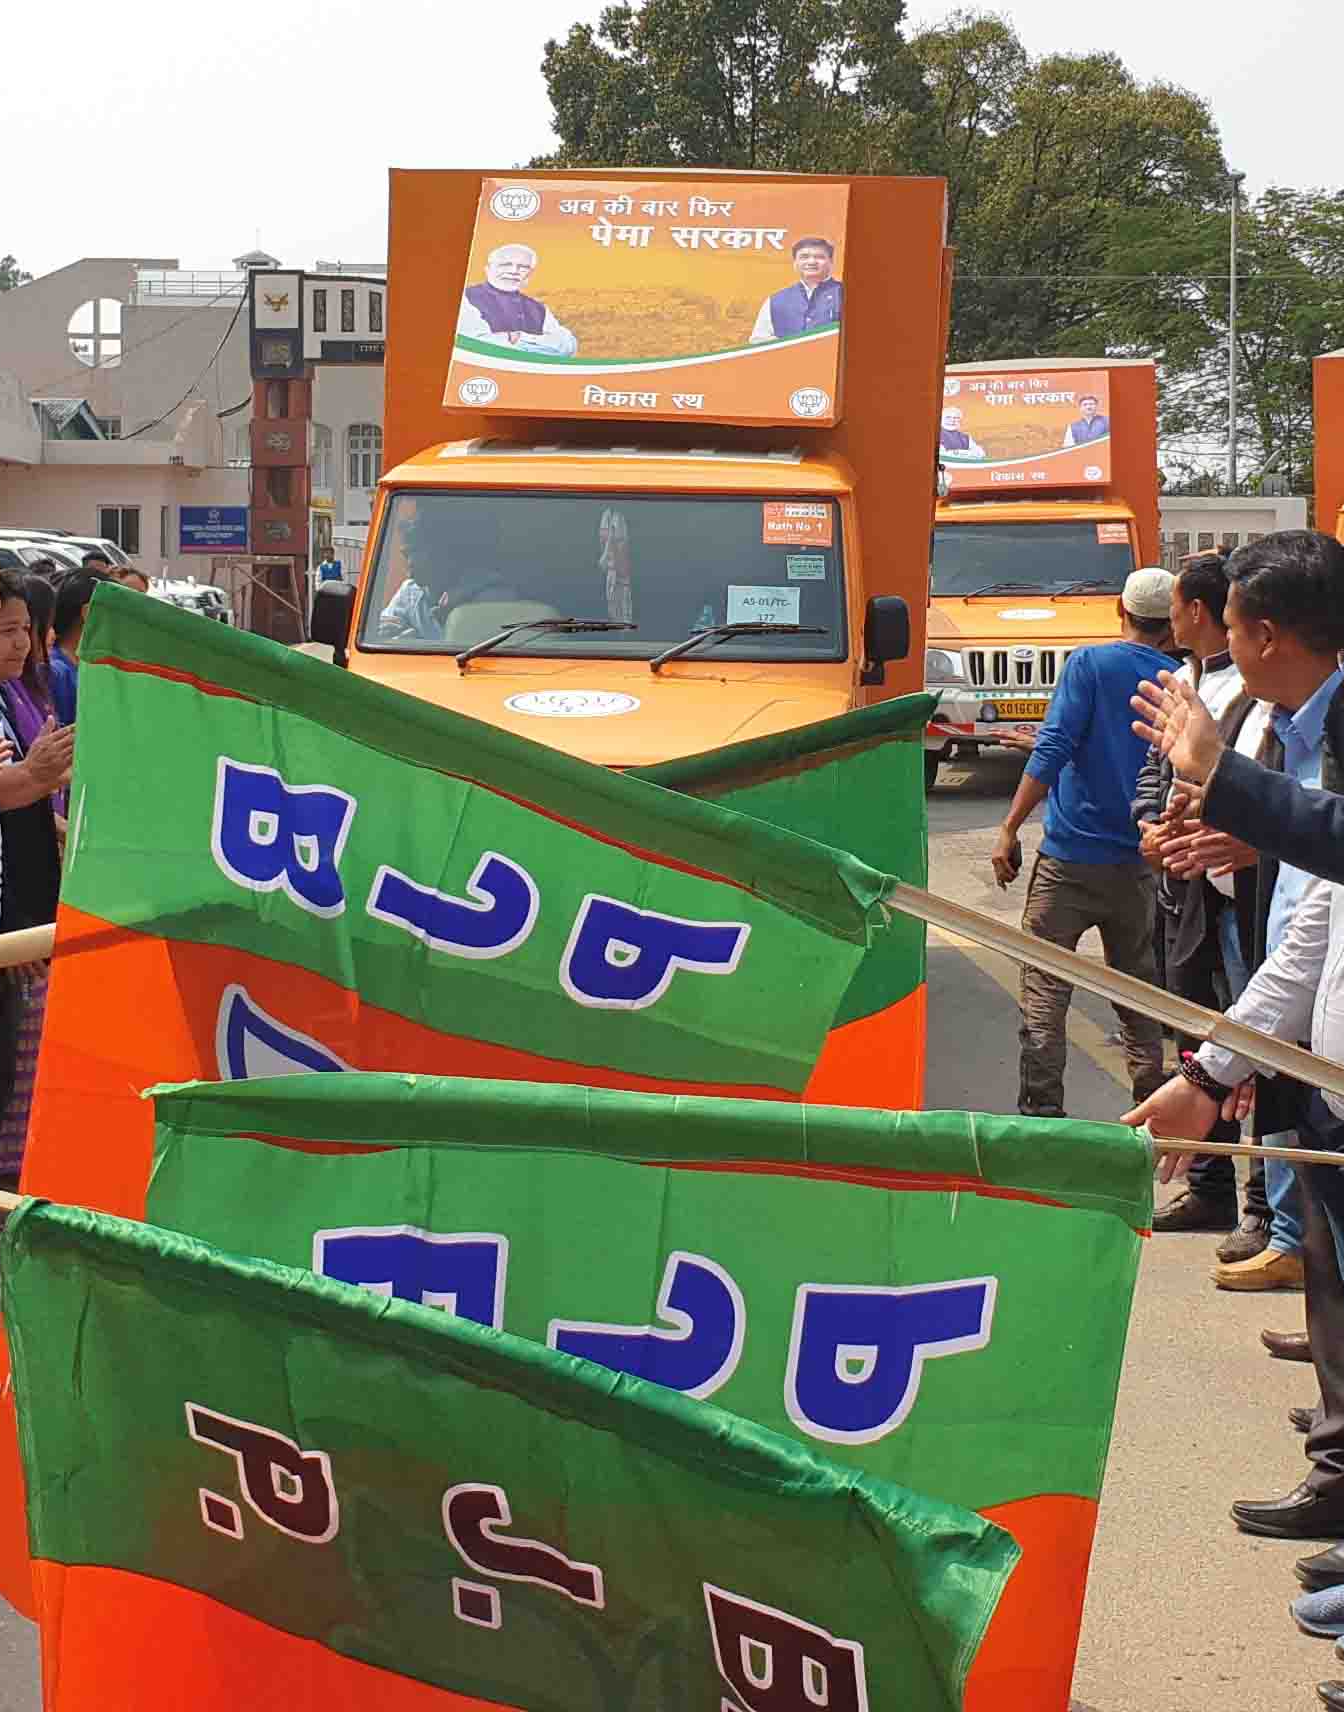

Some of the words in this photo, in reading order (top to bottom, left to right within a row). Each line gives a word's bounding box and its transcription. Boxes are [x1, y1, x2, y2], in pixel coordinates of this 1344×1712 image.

[560, 198, 595, 216] अब
[604, 195, 633, 216] की
[640, 199, 680, 217] बार
[689, 195, 735, 217] फिर
[590, 216, 654, 248] पेमा
[670, 225, 788, 250] सरकार
[582, 383, 660, 408] विकास
